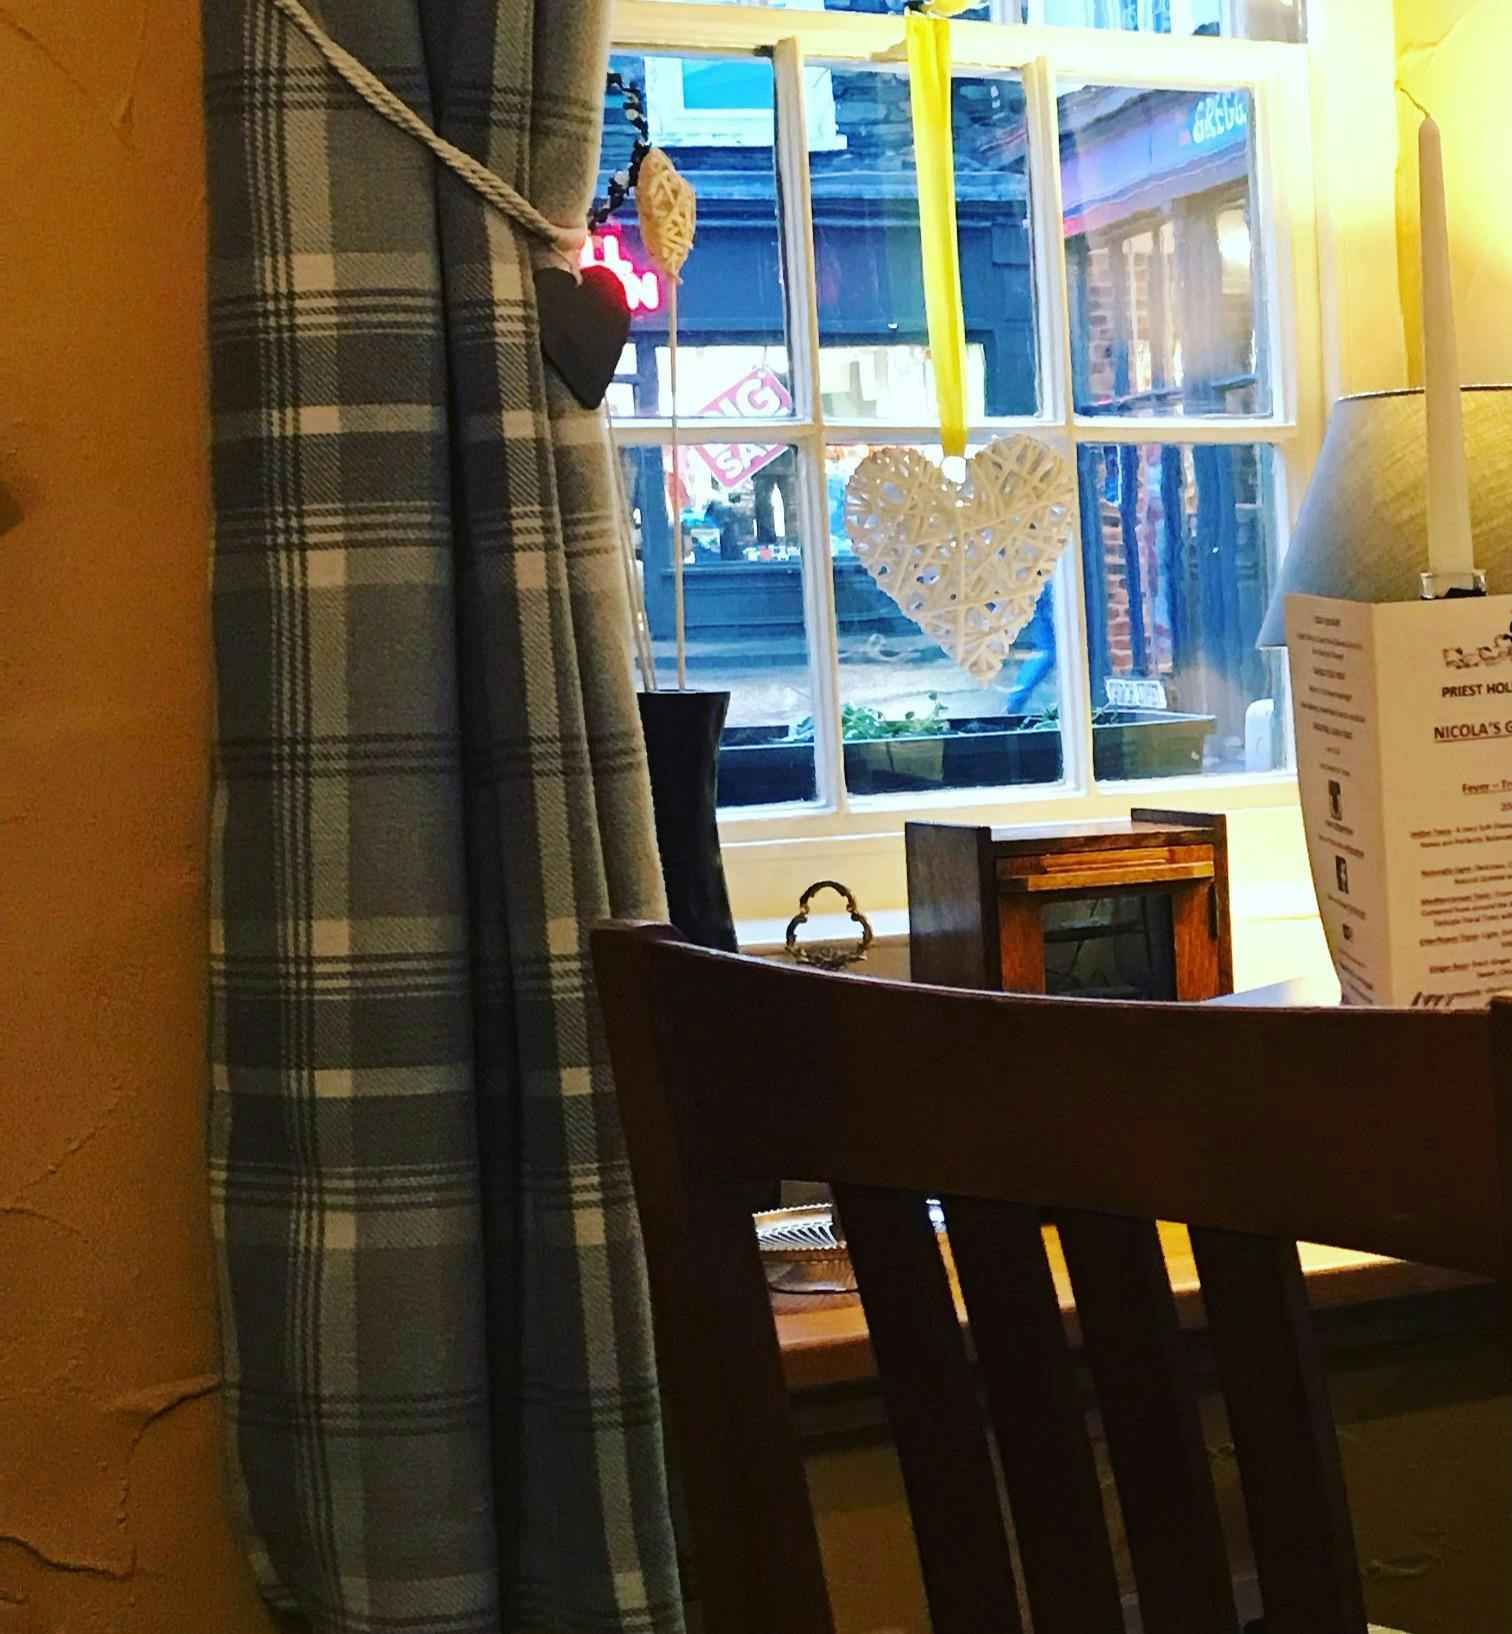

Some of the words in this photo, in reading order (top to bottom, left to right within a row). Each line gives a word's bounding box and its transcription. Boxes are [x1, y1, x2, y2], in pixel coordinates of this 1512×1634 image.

[1441, 683, 1483, 698] PRIEST
[1433, 720, 1501, 743] NICOLA'S
[1462, 783, 1490, 795] Fever
